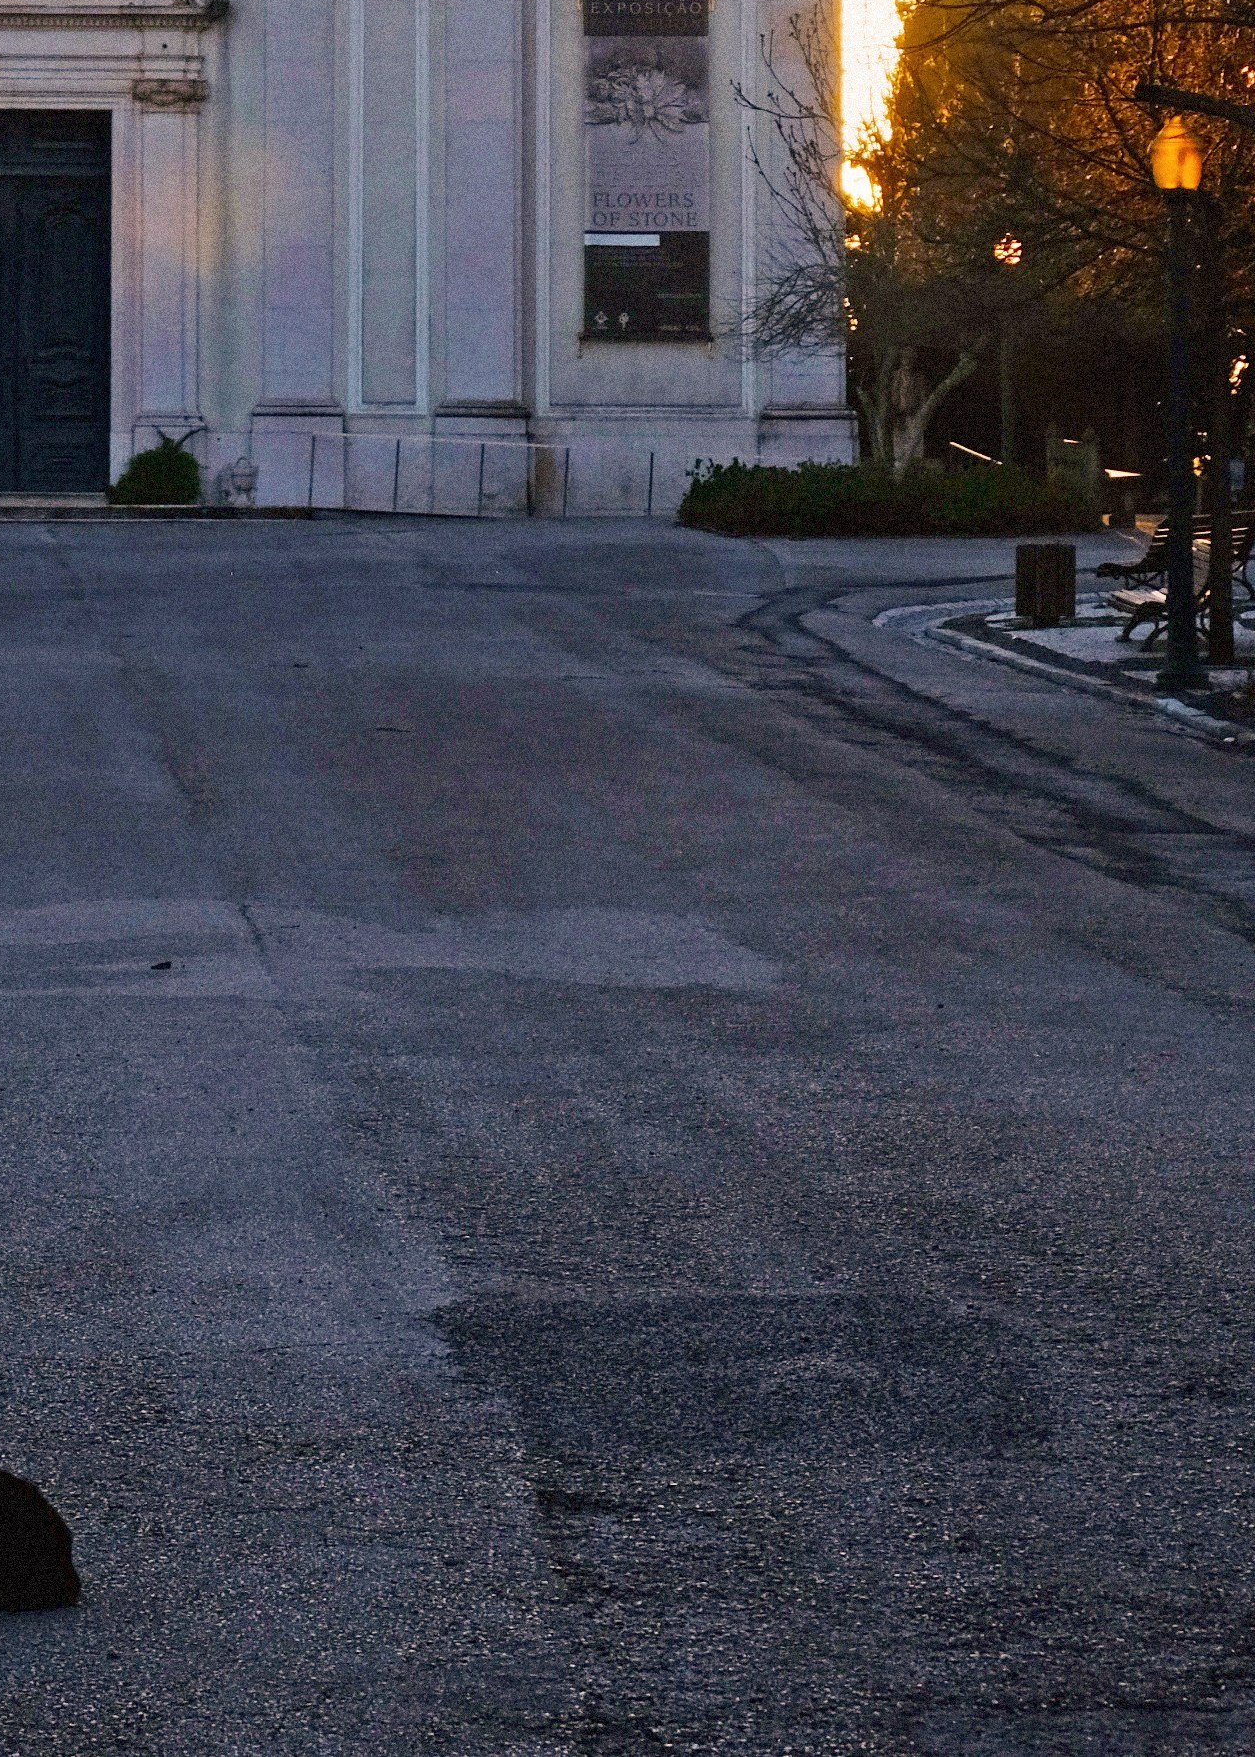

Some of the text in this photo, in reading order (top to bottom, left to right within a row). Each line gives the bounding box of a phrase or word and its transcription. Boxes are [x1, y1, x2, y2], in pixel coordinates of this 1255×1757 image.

[591, 0, 703, 17] EXPOSIÇÃO
[593, 192, 695, 209] FLOWERS
[593, 211, 698, 227] OF STONE
